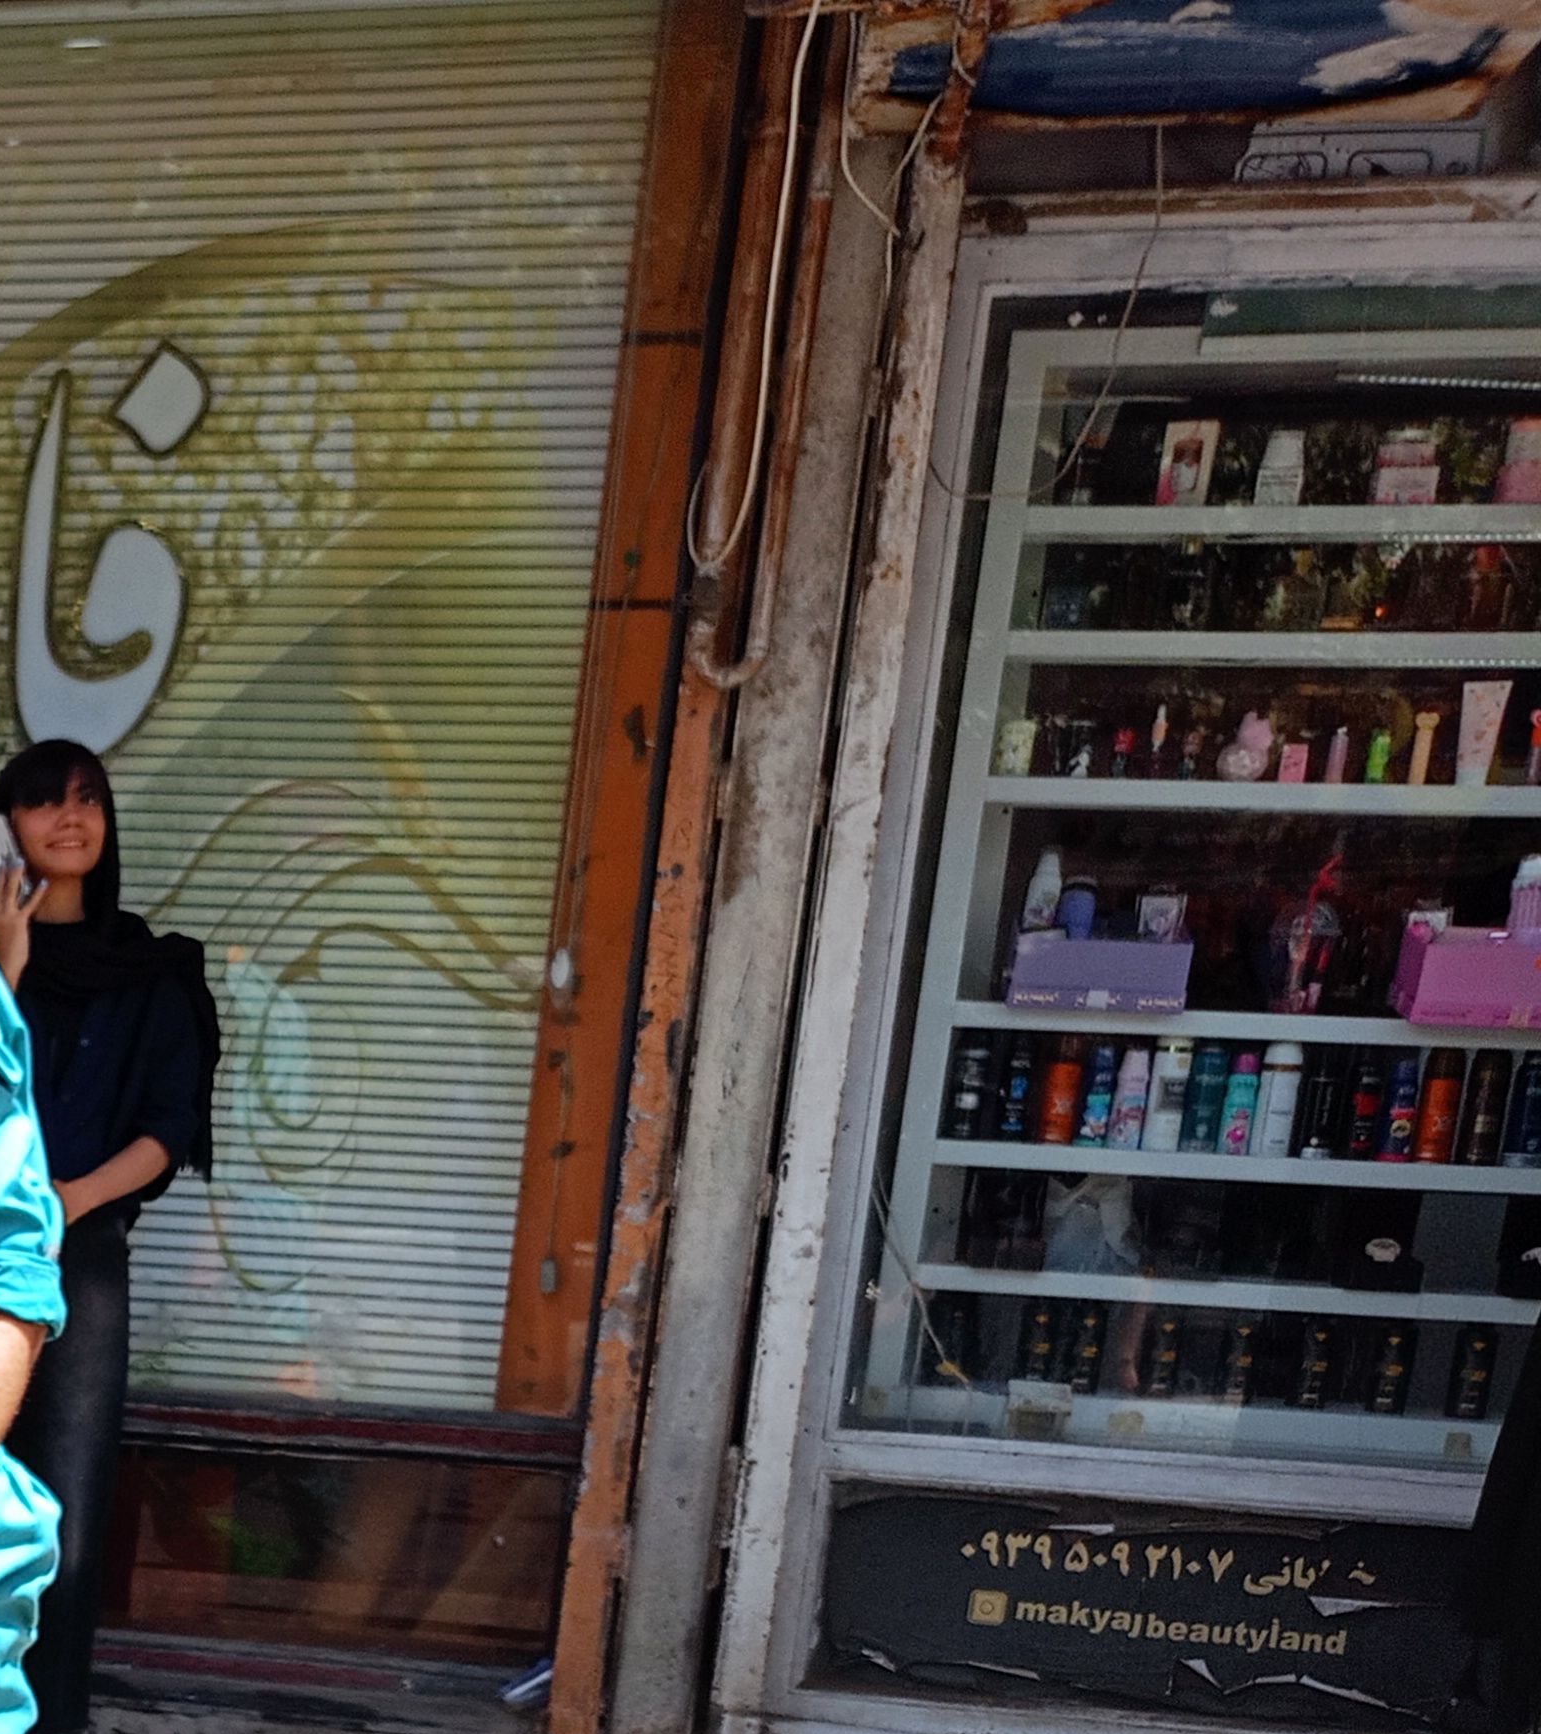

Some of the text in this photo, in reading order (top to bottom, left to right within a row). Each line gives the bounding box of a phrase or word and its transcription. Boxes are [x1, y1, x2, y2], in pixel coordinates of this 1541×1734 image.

[960, 1530, 1052, 1571] ۰۹۳۹
[1063, 1541, 1130, 1577] ۵۰۹
[1144, 1544, 1235, 1584] ۲۱۰۷
[1015, 1599, 1348, 1656] makyajbeautyland
